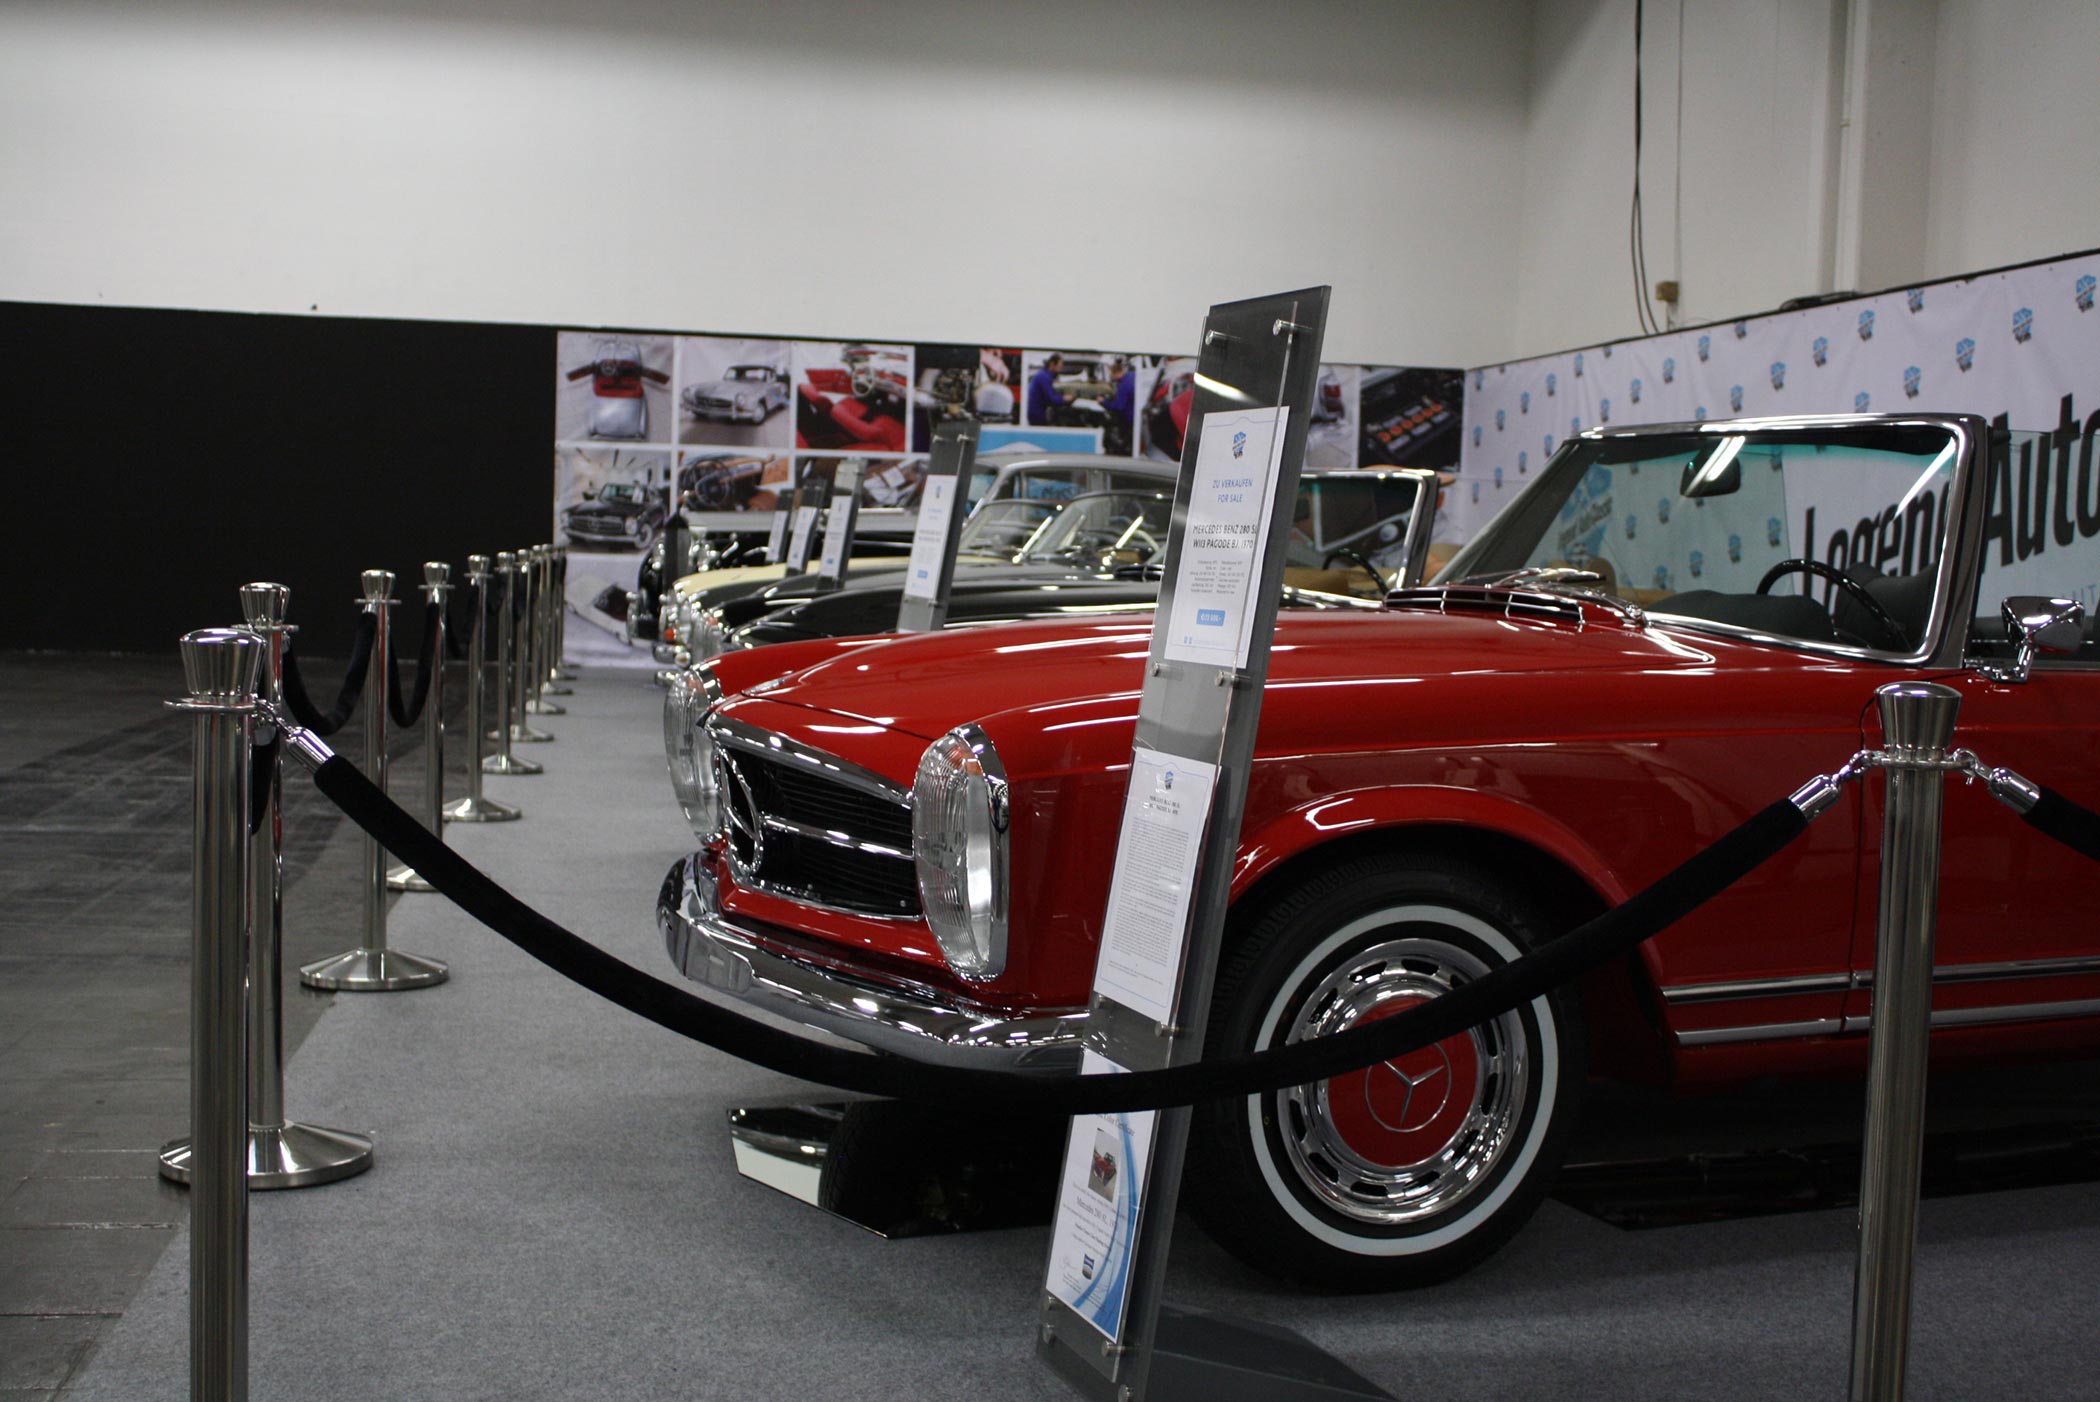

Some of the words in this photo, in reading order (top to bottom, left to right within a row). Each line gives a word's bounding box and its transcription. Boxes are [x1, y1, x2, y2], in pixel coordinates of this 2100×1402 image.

[1212, 479, 1221, 489] ZU
[1221, 478, 1253, 489] VERKAUFEN
[1217, 494, 1229, 503] FOR
[1230, 493, 1244, 503] SALE
[1193, 524, 1222, 535] MERCEDES
[1223, 524, 1239, 535] BENZ
[1239, 524, 1251, 535] 280
[1206, 538, 1232, 549] PAGODE
